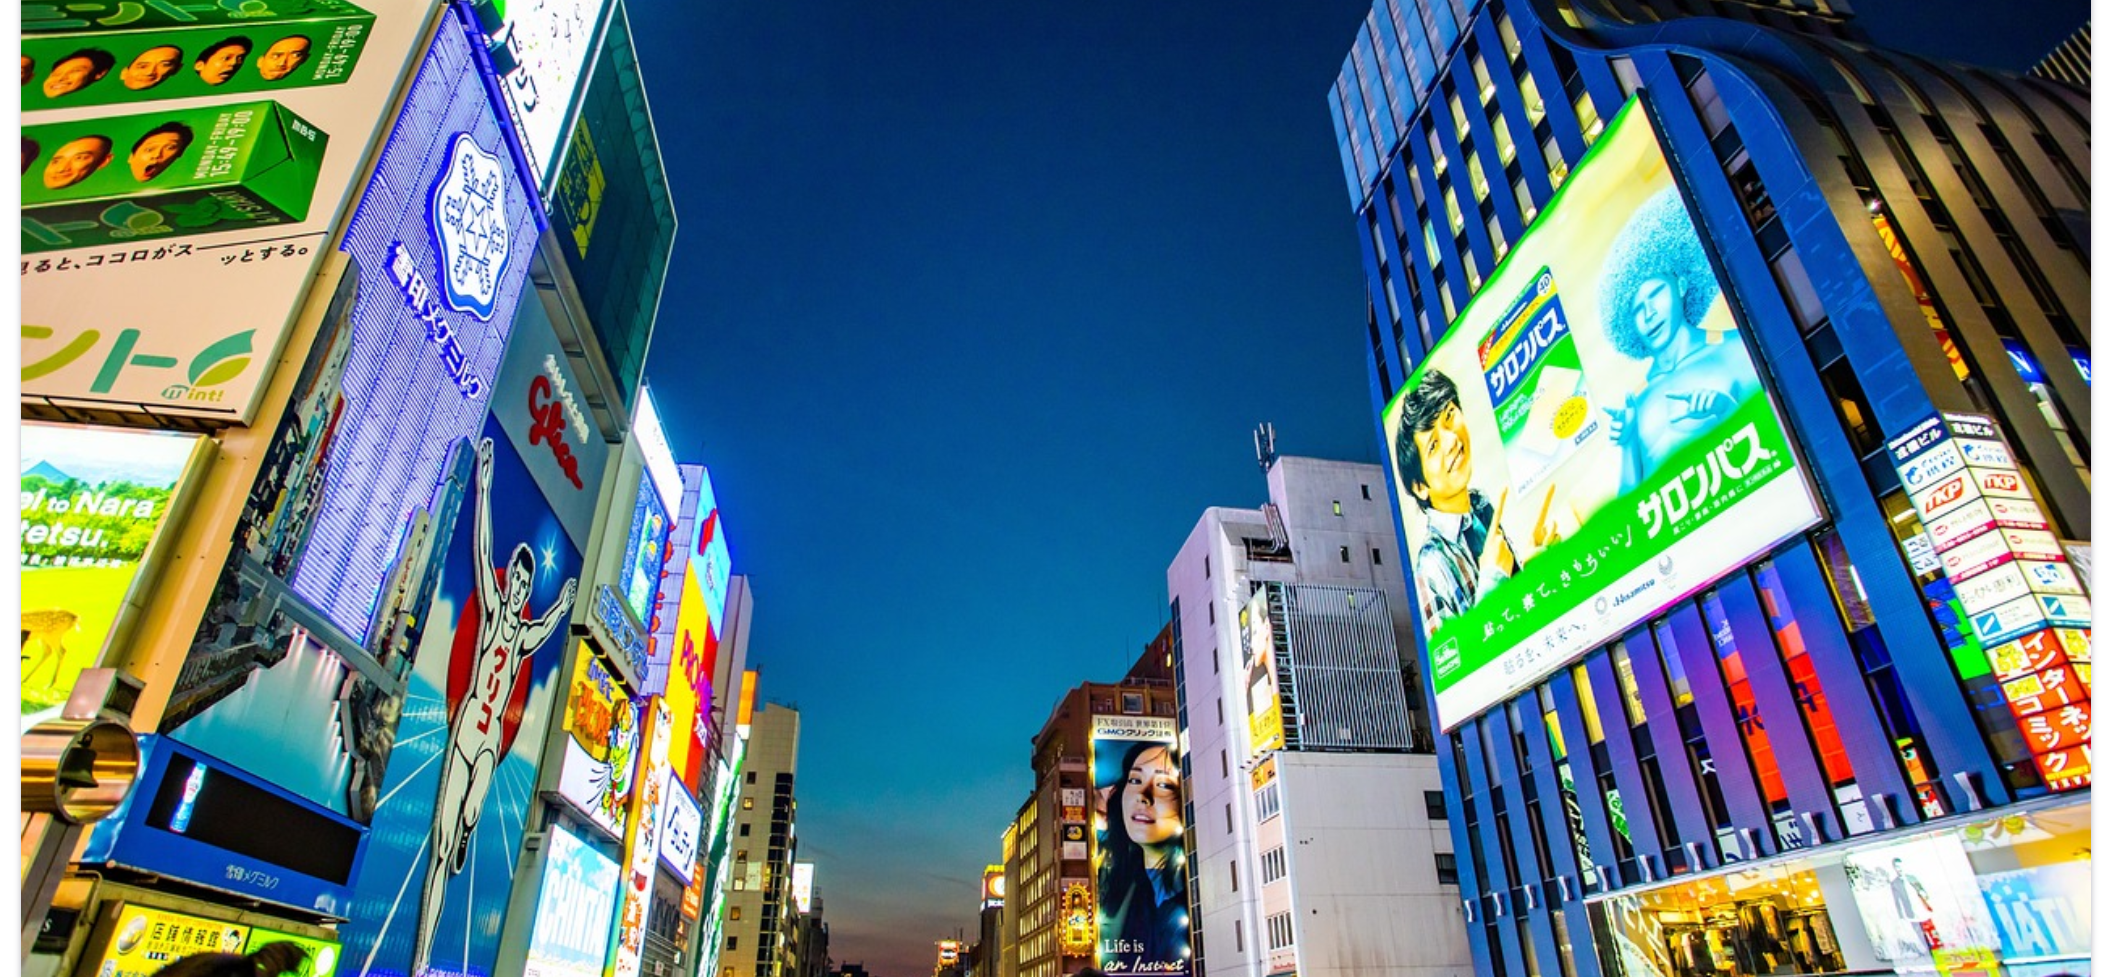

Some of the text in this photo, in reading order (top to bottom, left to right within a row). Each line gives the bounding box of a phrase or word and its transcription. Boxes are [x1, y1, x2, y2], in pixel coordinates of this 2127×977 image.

[325, 24, 363, 79] 15:49-19:00
[194, 113, 233, 180] MONDAY-FRIDAY
[210, 110, 254, 178] 15:49-19:00
[1490, 306, 1564, 397] サロンパス
[529, 375, 584, 490] Glico
[47, 496, 70, 513] to
[74, 491, 154, 518] Nara
[1637, 422, 1775, 540] サロンパス
[1925, 479, 1963, 514] TKP
[1984, 474, 2018, 491] TKP
[476, 645, 510, 735] グリコ
[2016, 696, 2068, 773] コミック
[1104, 939, 1145, 953] Life is
[1104, 960, 1128, 972] an
